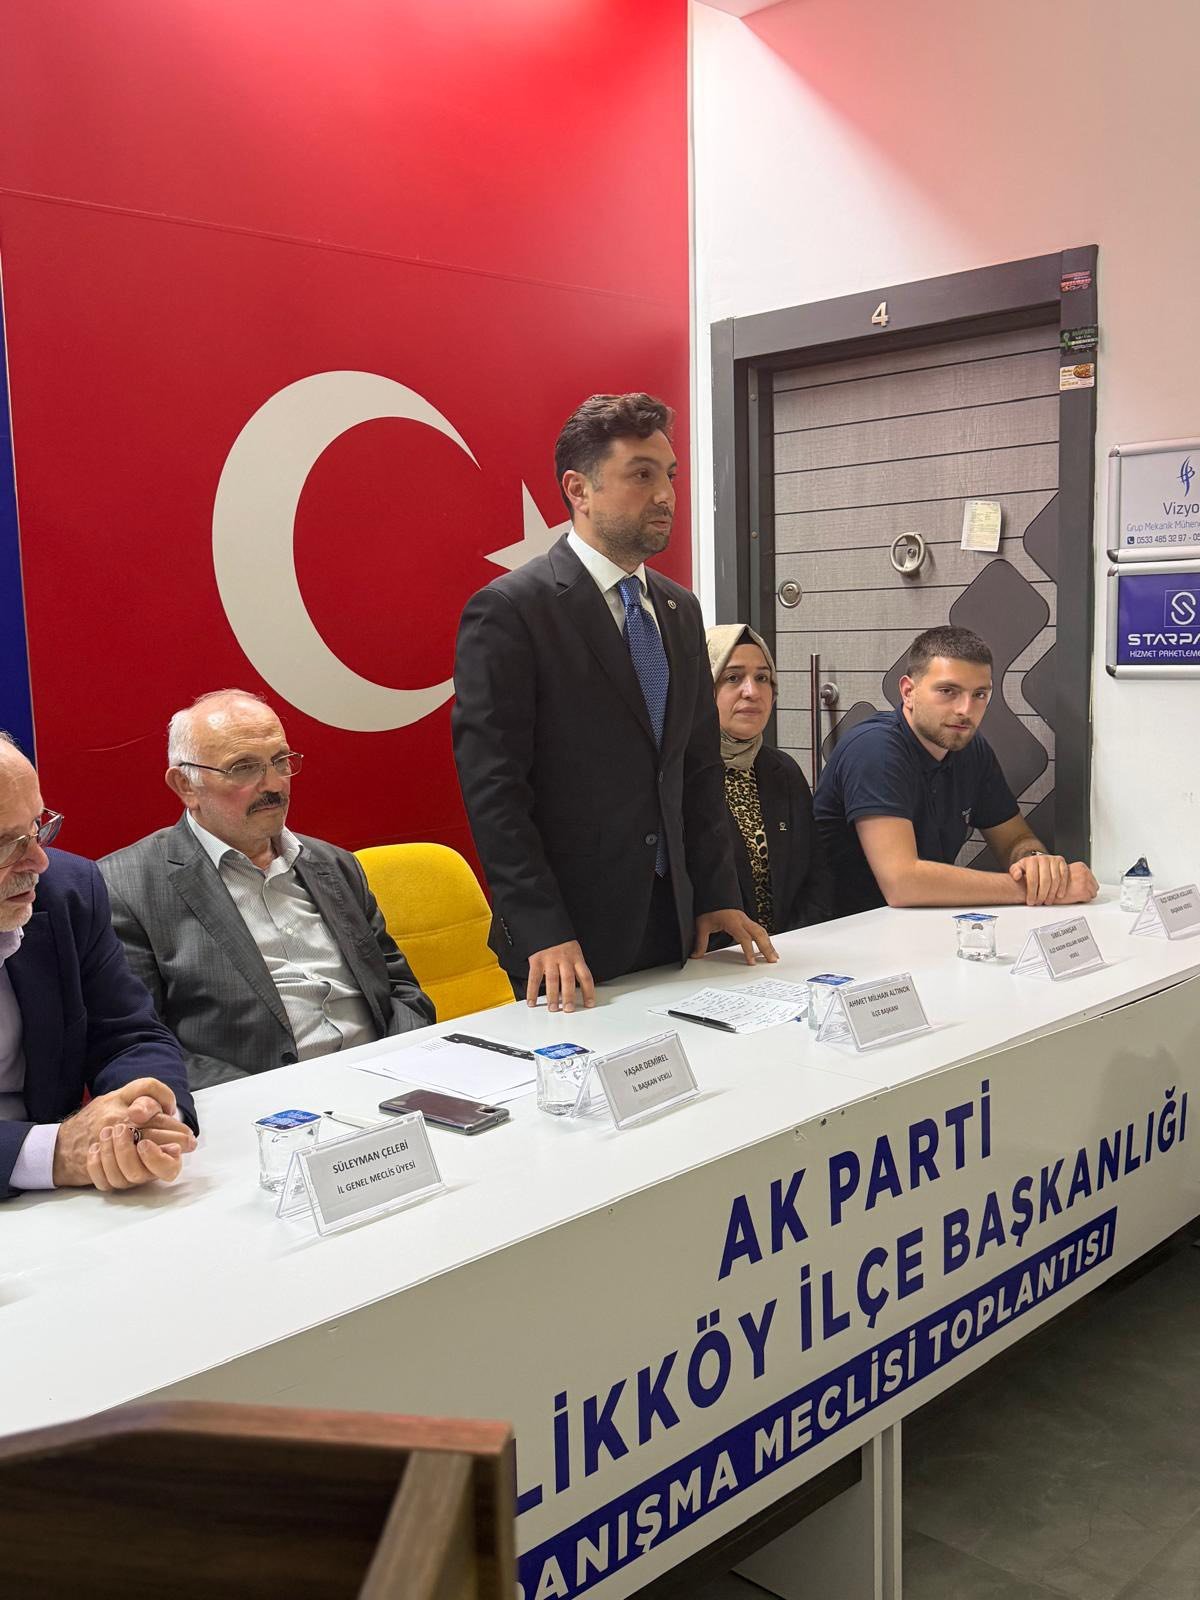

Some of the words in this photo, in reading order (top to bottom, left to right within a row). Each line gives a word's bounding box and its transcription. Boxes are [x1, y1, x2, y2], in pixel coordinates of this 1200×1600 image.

[871, 301, 889, 327] 4
[1163, 502, 1200, 517] Vizyo
[1129, 649, 1157, 658] HİZMET
[848, 997, 867, 1008] AHMET
[623, 1063, 644, 1077] YAŞAR
[643, 1053, 669, 1071] DEMİREL
[638, 1078, 658, 1091] BAŞKAN
[658, 1071, 673, 1083] VEKİLİ
[332, 1151, 380, 1174] SÜLEYMAN
[381, 1139, 409, 1158] ÇELEBİ
[337, 1185, 345, 1195] İL
[345, 1179, 369, 1192] GENEL
[369, 1168, 396, 1183] MECLİS
[396, 1160, 416, 1175] ÜYESİ
[718, 1168, 807, 1281] AK
[828, 1079, 991, 1228] PARTİ
[800, 1227, 924, 1353] İLÇE
[943, 1085, 1187, 1276] BAŞKANLIĞI
[755, 1328, 917, 1473] MECLİSİ
[929, 1223, 1110, 1362] TOPLANTISI
